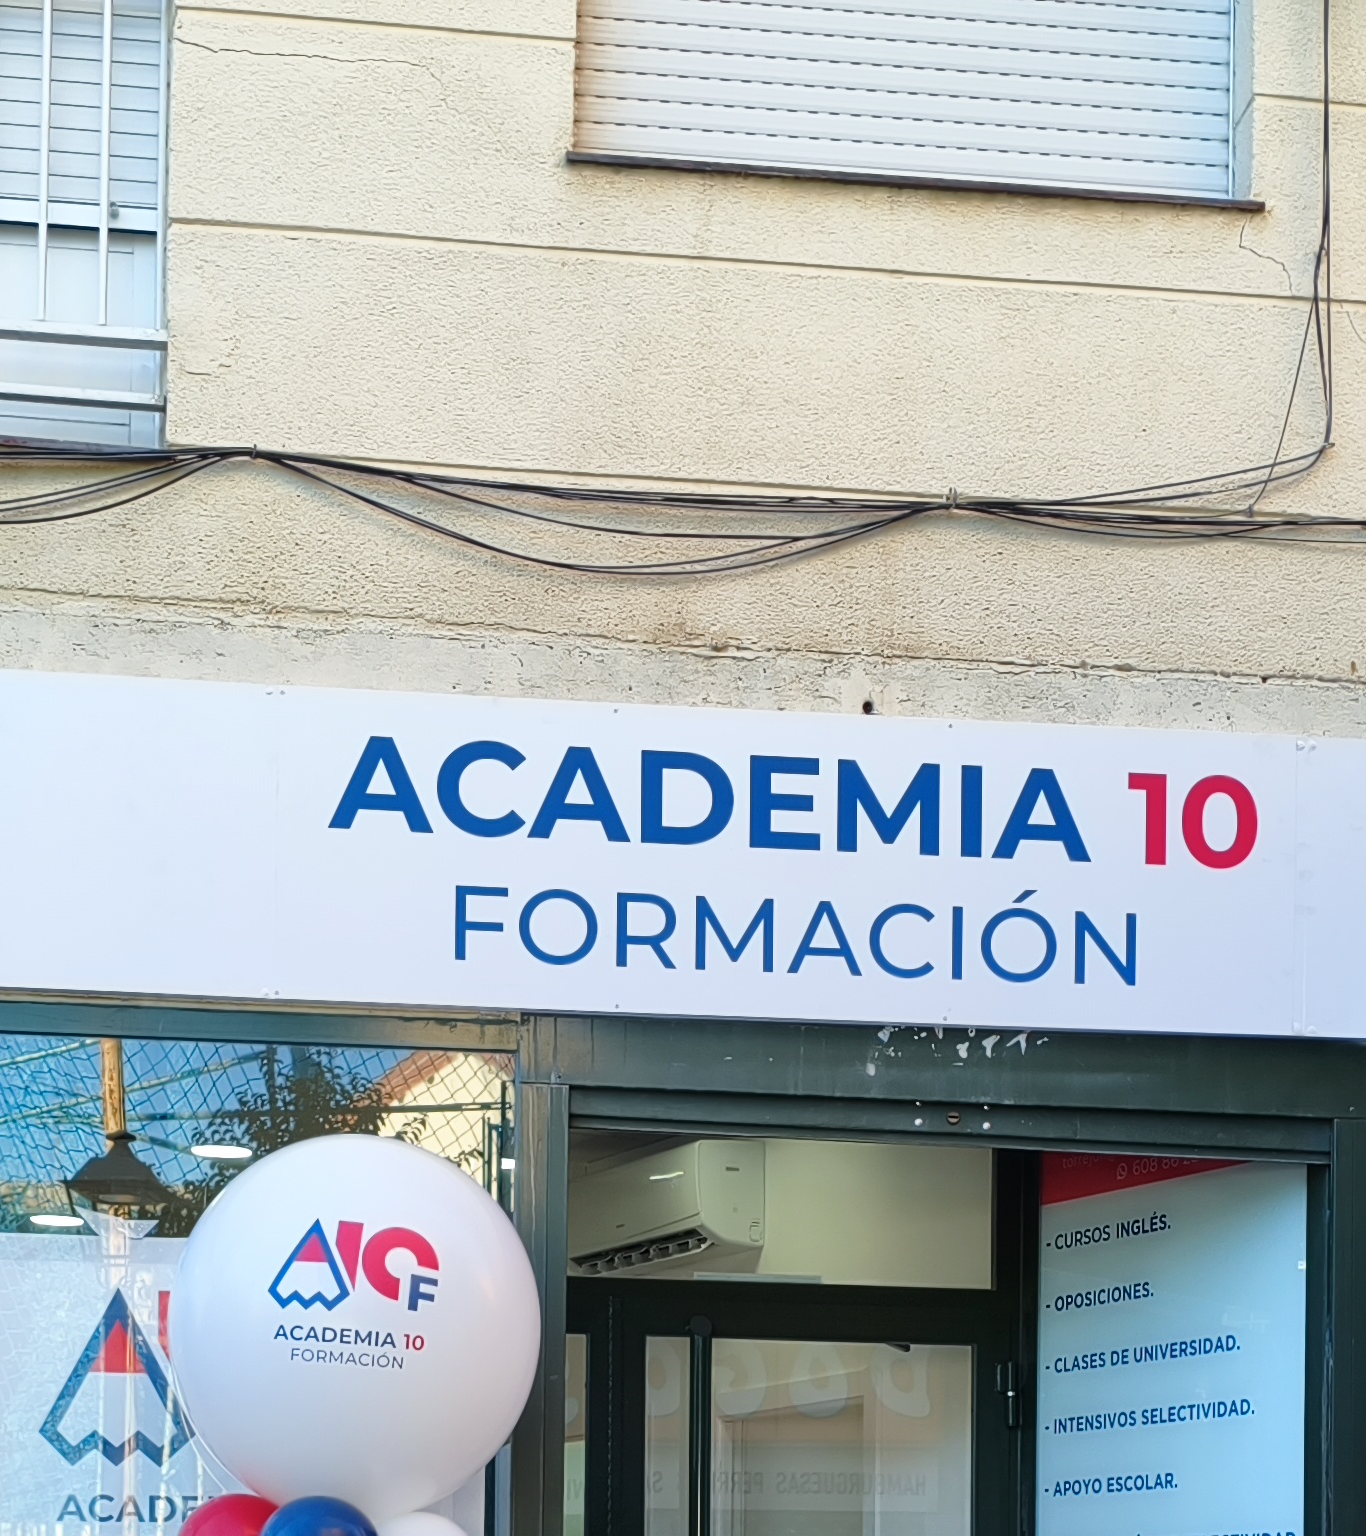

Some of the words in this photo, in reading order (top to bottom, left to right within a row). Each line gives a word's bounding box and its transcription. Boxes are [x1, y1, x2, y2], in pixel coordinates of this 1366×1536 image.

[328, 735, 1091, 863] ACADEMIA
[1128, 772, 1258, 869] 10
[454, 885, 1138, 987] FORMACIÓN
[1055, 1225, 1110, 1250] CURSOS
[1116, 1211, 1171, 1239] INGLÉS.
[1054, 1282, 1154, 1312] OPOSICIONES.
[274, 1325, 396, 1348] ACADEMIA
[404, 1333, 425, 1351] 10
[1054, 1352, 1107, 1374] CLASES
[1110, 1348, 1130, 1367] DE
[1133, 1334, 1241, 1364] UNIVERSIDAD.
[291, 1347, 404, 1369] FORMACIÓN
[1053, 1410, 1137, 1435] INTENSIVOS
[1141, 1398, 1255, 1427] SELECTIVIDAD.
[1053, 1477, 1102, 1497] APOYO
[1106, 1473, 1178, 1494] ESCOLAR.
